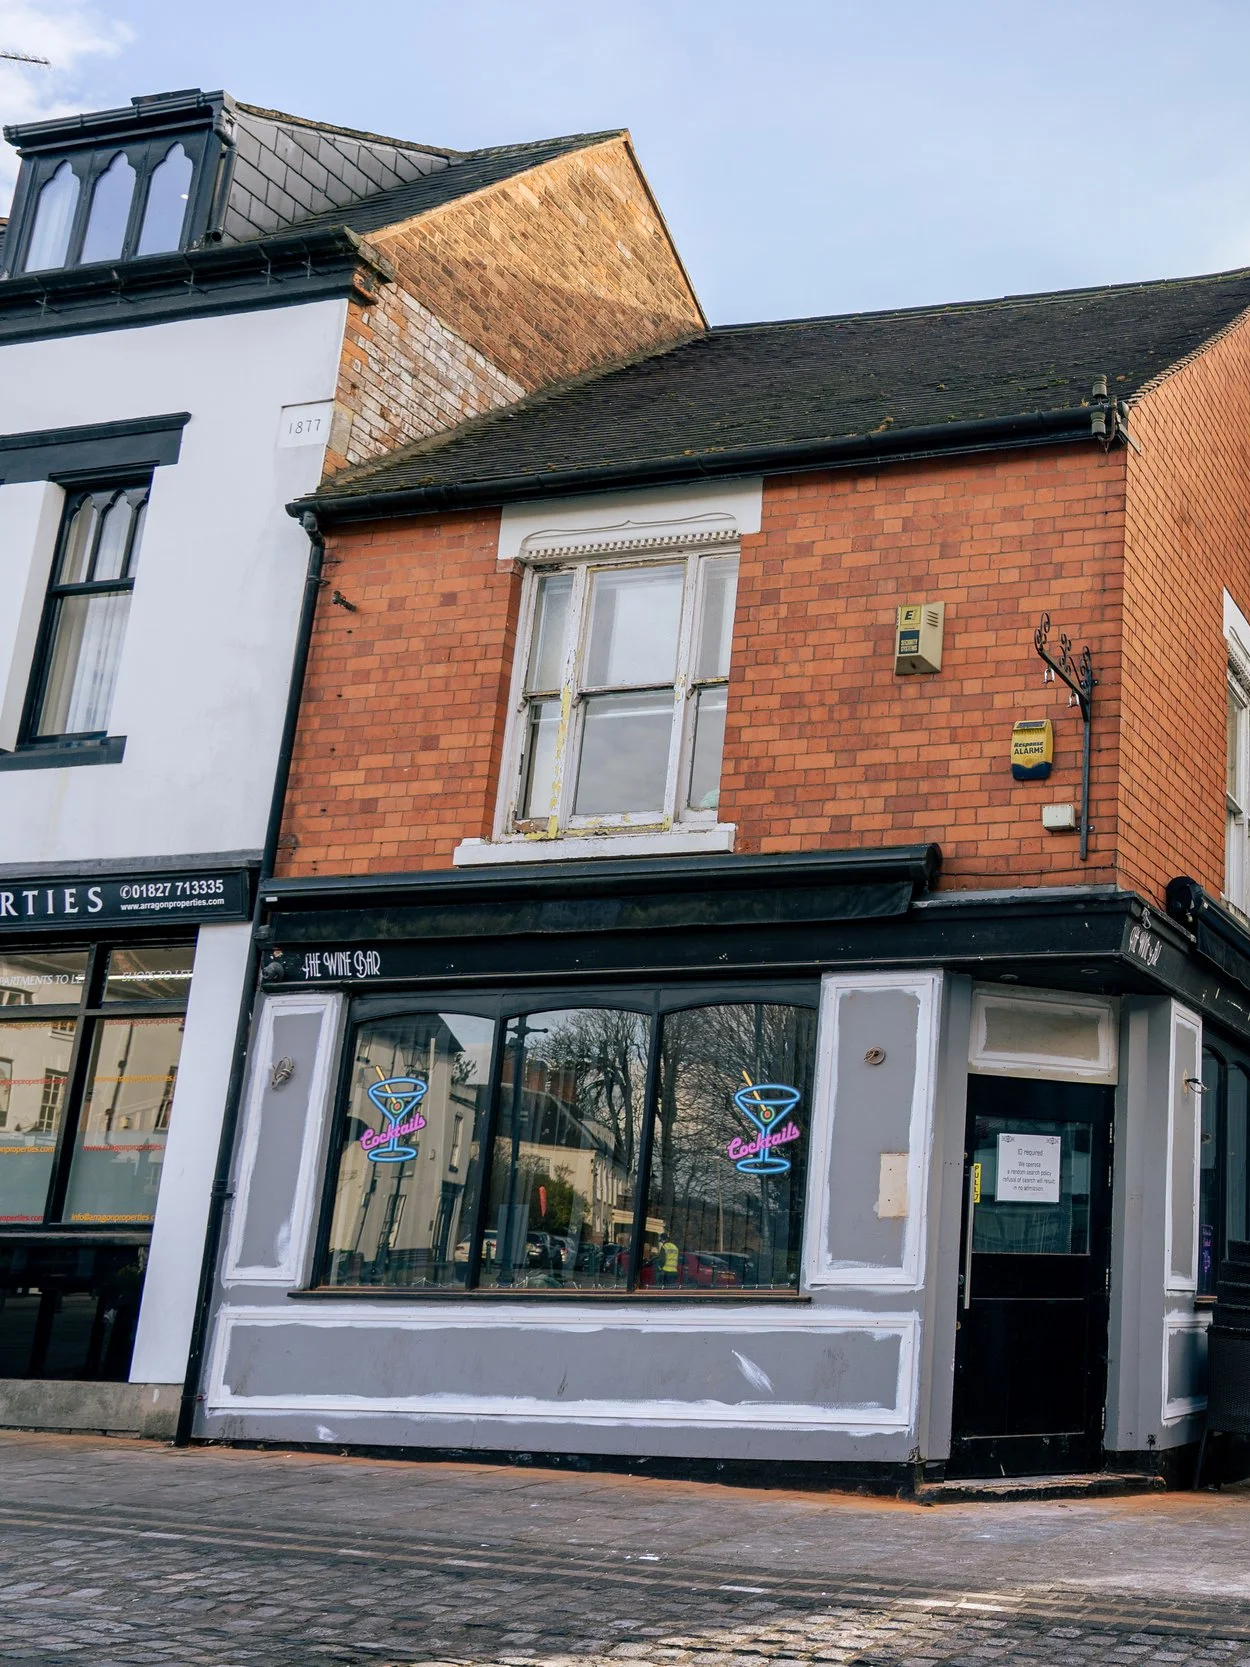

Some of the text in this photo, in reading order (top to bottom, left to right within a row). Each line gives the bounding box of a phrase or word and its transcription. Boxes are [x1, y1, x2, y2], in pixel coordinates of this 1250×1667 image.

[288, 418, 321, 434] 1877
[1013, 746, 1044, 755] ALARMS
[132, 880, 224, 899] 01827 713335
[120, 898, 225, 911] www.arragonproperties.com
[301, 950, 381, 979] THE WINE BAR
[55, 974, 69, 985] TO
[360, 1111, 427, 1151] Cocktails
[727, 1120, 801, 1160] Cocktails
[1024, 1148, 1044, 1156] required
